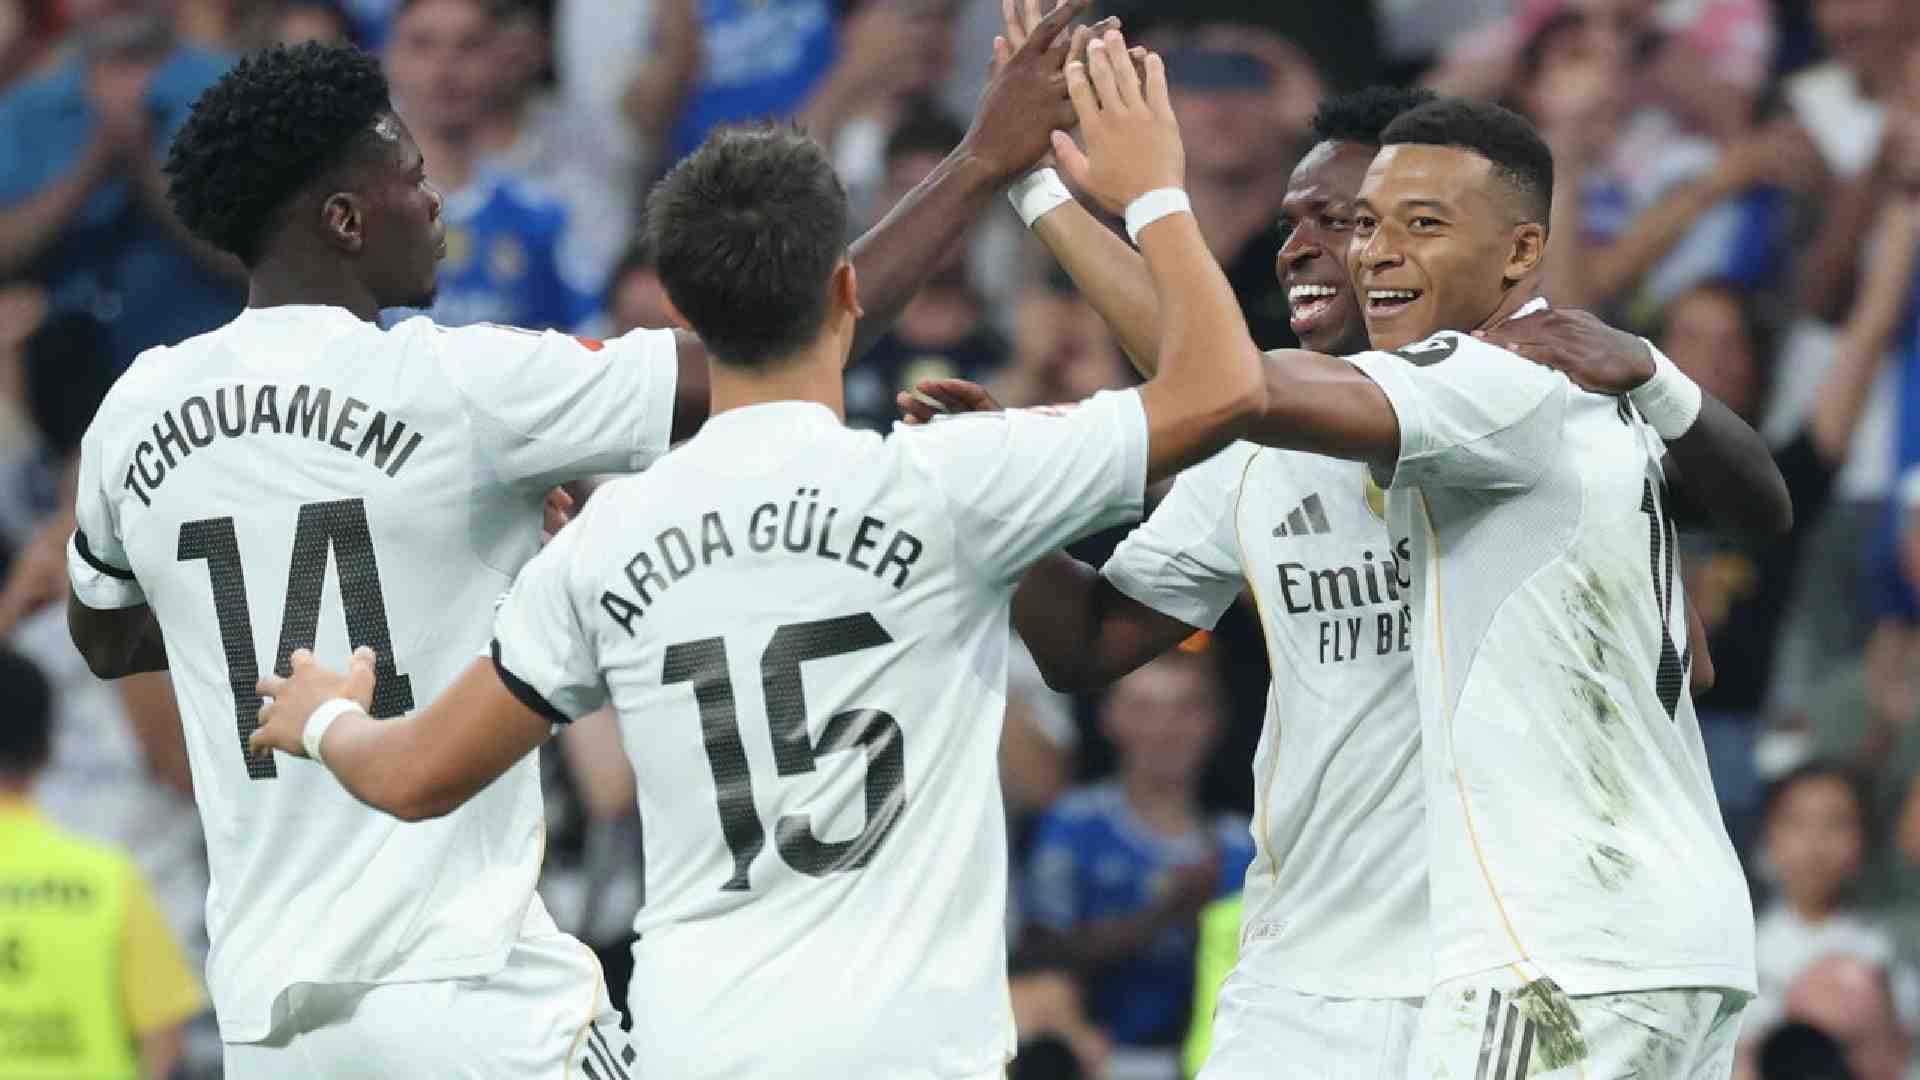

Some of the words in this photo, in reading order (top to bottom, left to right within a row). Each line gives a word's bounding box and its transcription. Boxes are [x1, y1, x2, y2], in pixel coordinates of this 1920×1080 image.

[124, 384, 424, 507] TCHOUAMENI
[600, 511, 734, 638] ARDA
[748, 487, 923, 588] GÜLER
[176, 497, 415, 780] 14
[1319, 617, 1362, 665] FLY
[661, 611, 906, 892] 15
